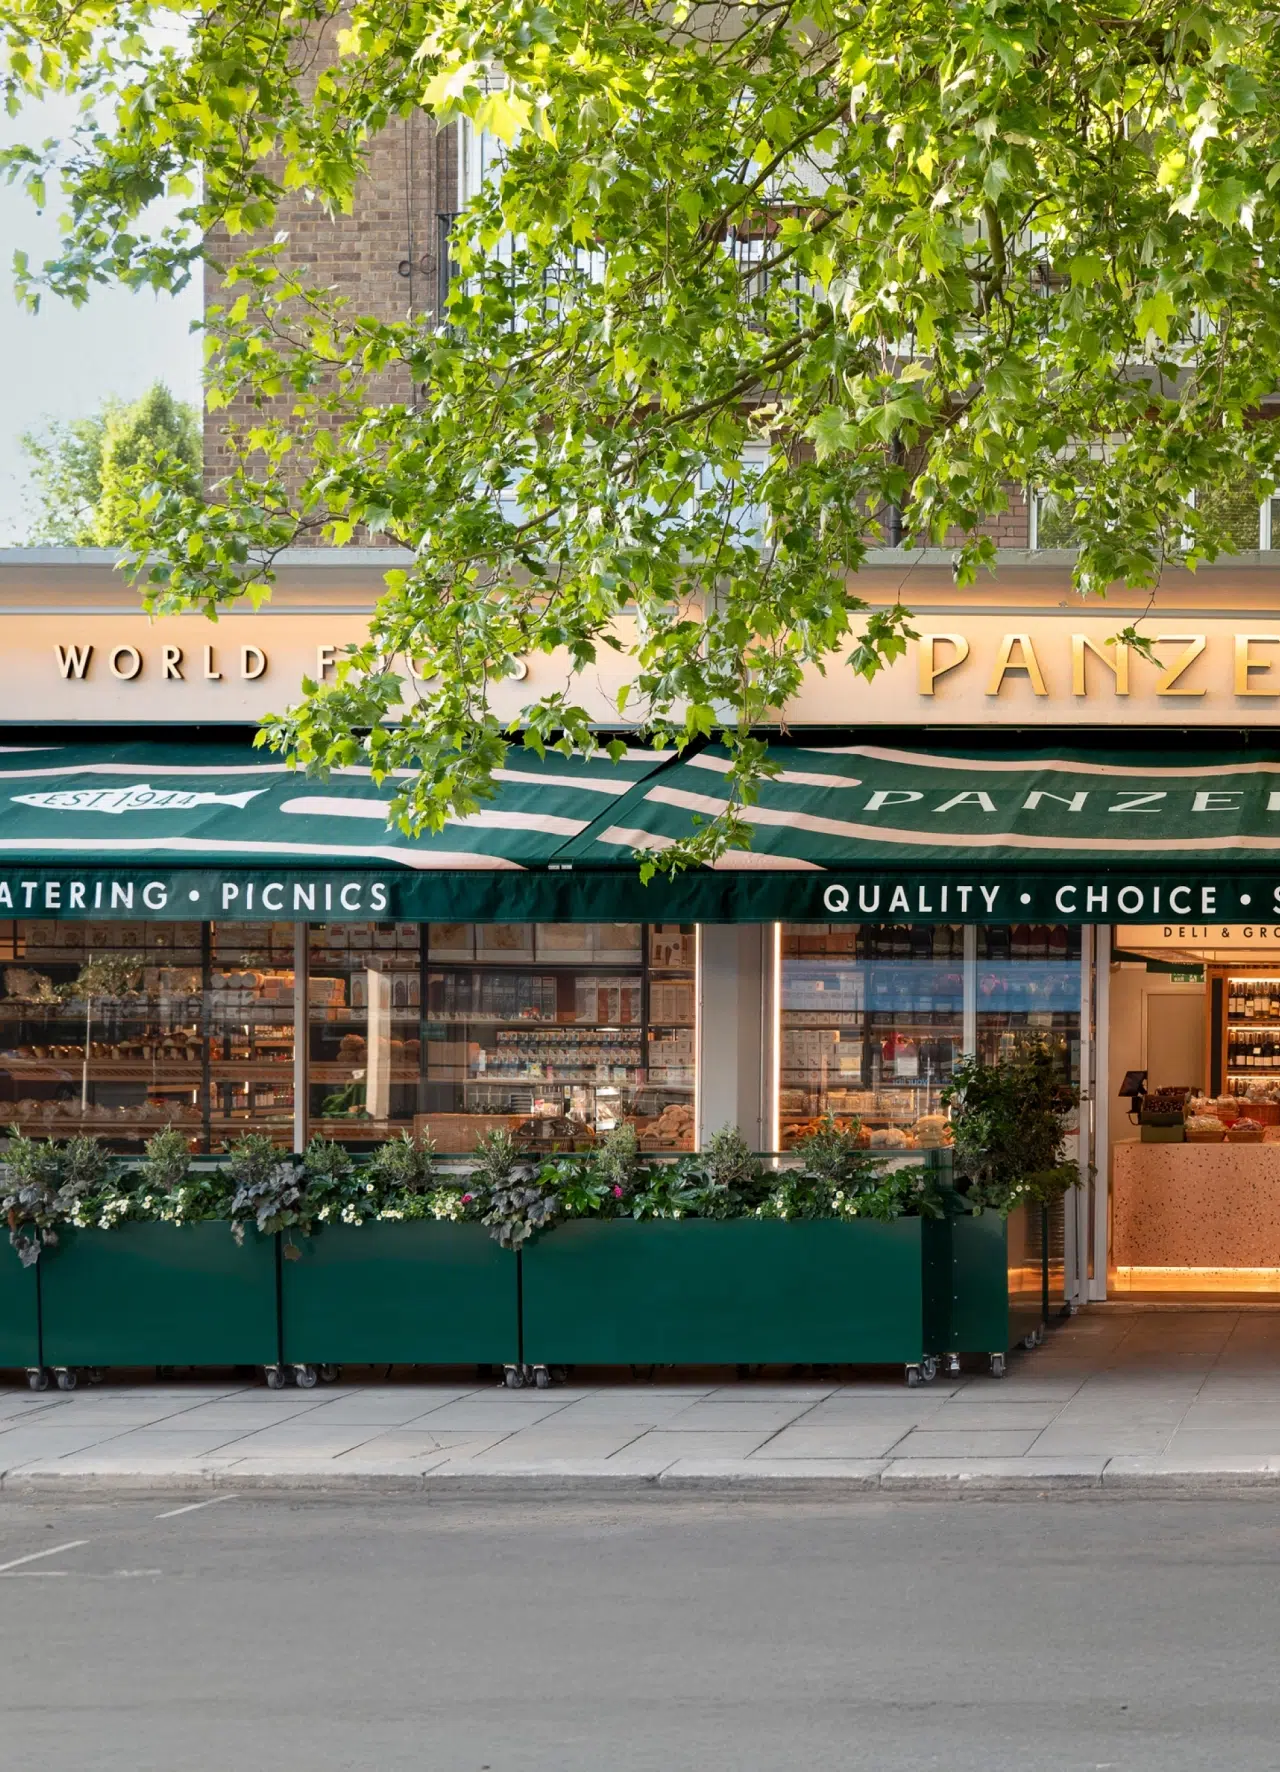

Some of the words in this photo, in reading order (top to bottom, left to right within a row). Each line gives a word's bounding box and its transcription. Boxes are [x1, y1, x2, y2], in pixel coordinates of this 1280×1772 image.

[54, 644, 269, 681] WORLD
[222, 882, 388, 911] PICNICS
[823, 884, 1002, 914] QUALITY
[1055, 885, 1217, 915] CHOICE
[1164, 927, 1207, 938] DELI
[1221, 927, 1230, 938] &
